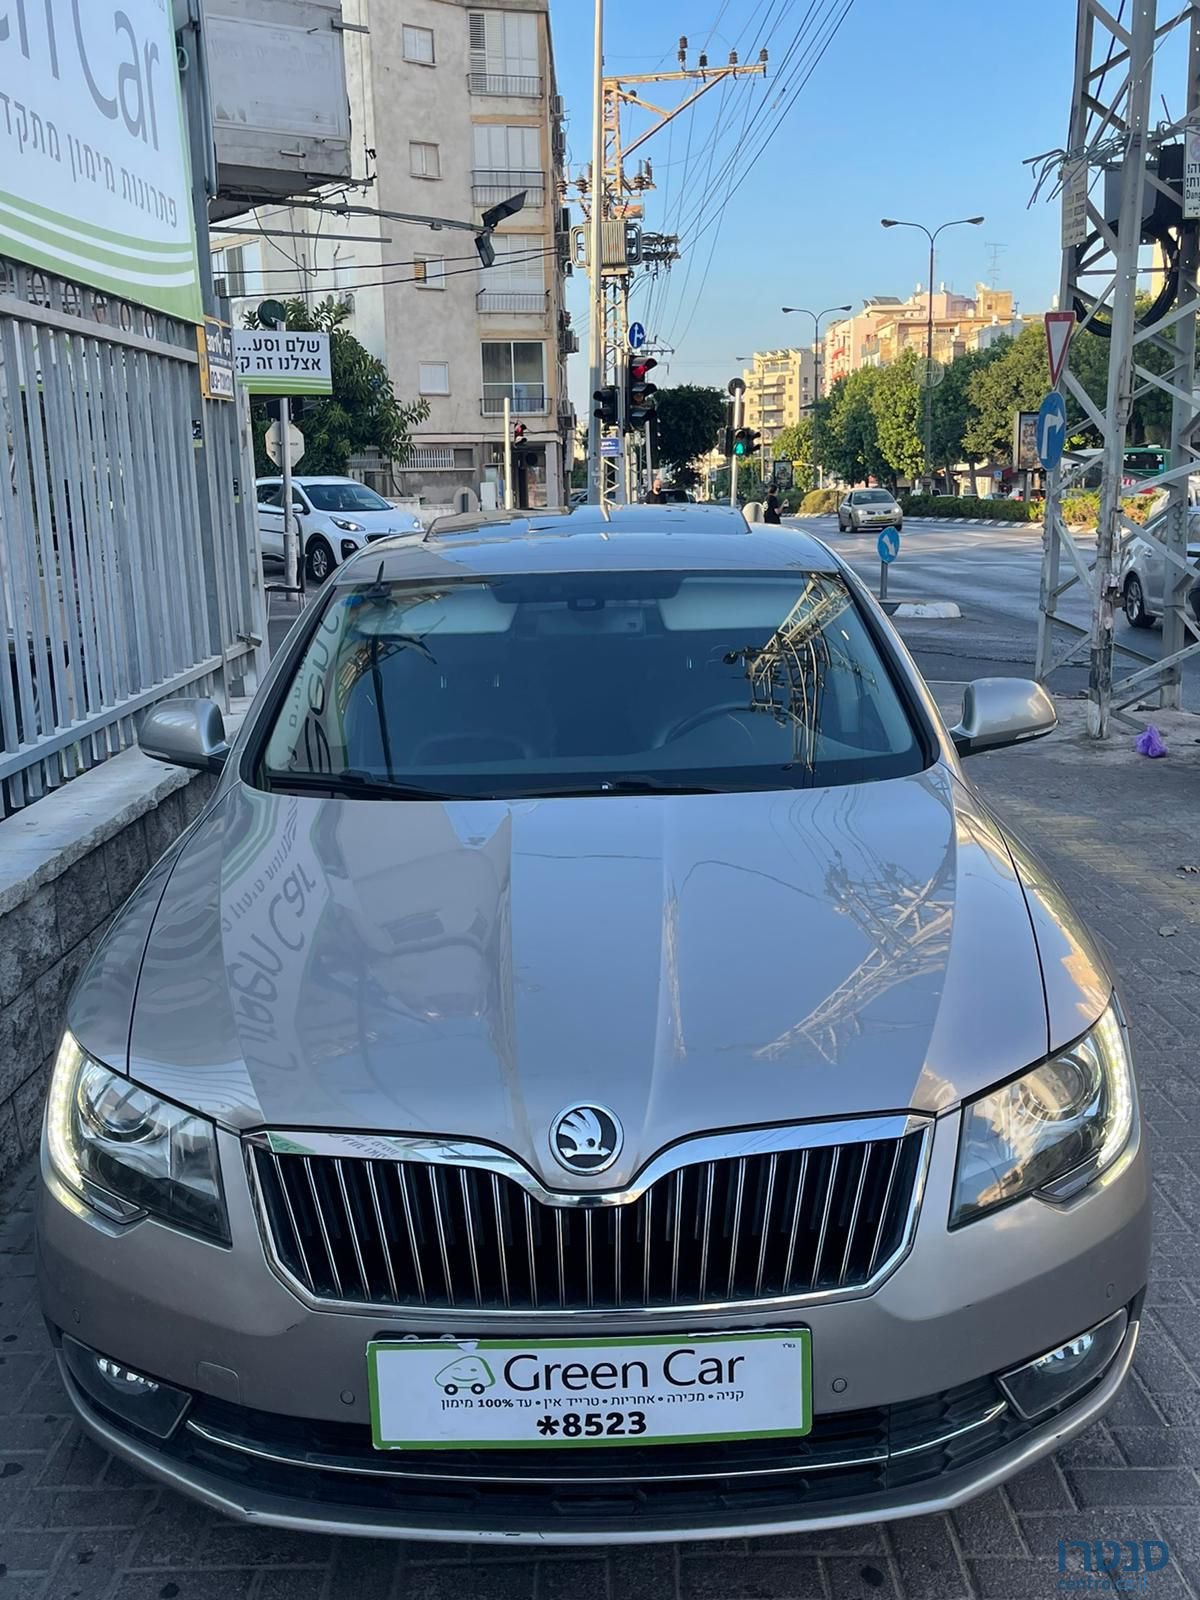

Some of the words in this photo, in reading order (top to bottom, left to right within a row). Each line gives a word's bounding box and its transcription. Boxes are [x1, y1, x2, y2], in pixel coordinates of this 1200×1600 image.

[71, 0, 160, 152] Car
[67, 133, 116, 193] מימון
[121, 167, 178, 229] פתרונות
[237, 338, 280, 352] וסע...
[286, 337, 320, 353] שלם
[256, 357, 273, 370] זה
[278, 354, 321, 371] אצלנו
[503, 1353, 649, 1391] Green
[662, 1348, 745, 1387] Car
[566, 1397, 600, 1407] טרייד
[611, 1394, 655, 1406] אחריות
[667, 1392, 705, 1403] מכירה
[716, 1390, 744, 1402] קניה
[441, 1399, 474, 1411] מימון
[478, 1398, 514, 1408] 100%
[516, 1399, 532, 1408] עד
[544, 1398, 562, 1410] אין
